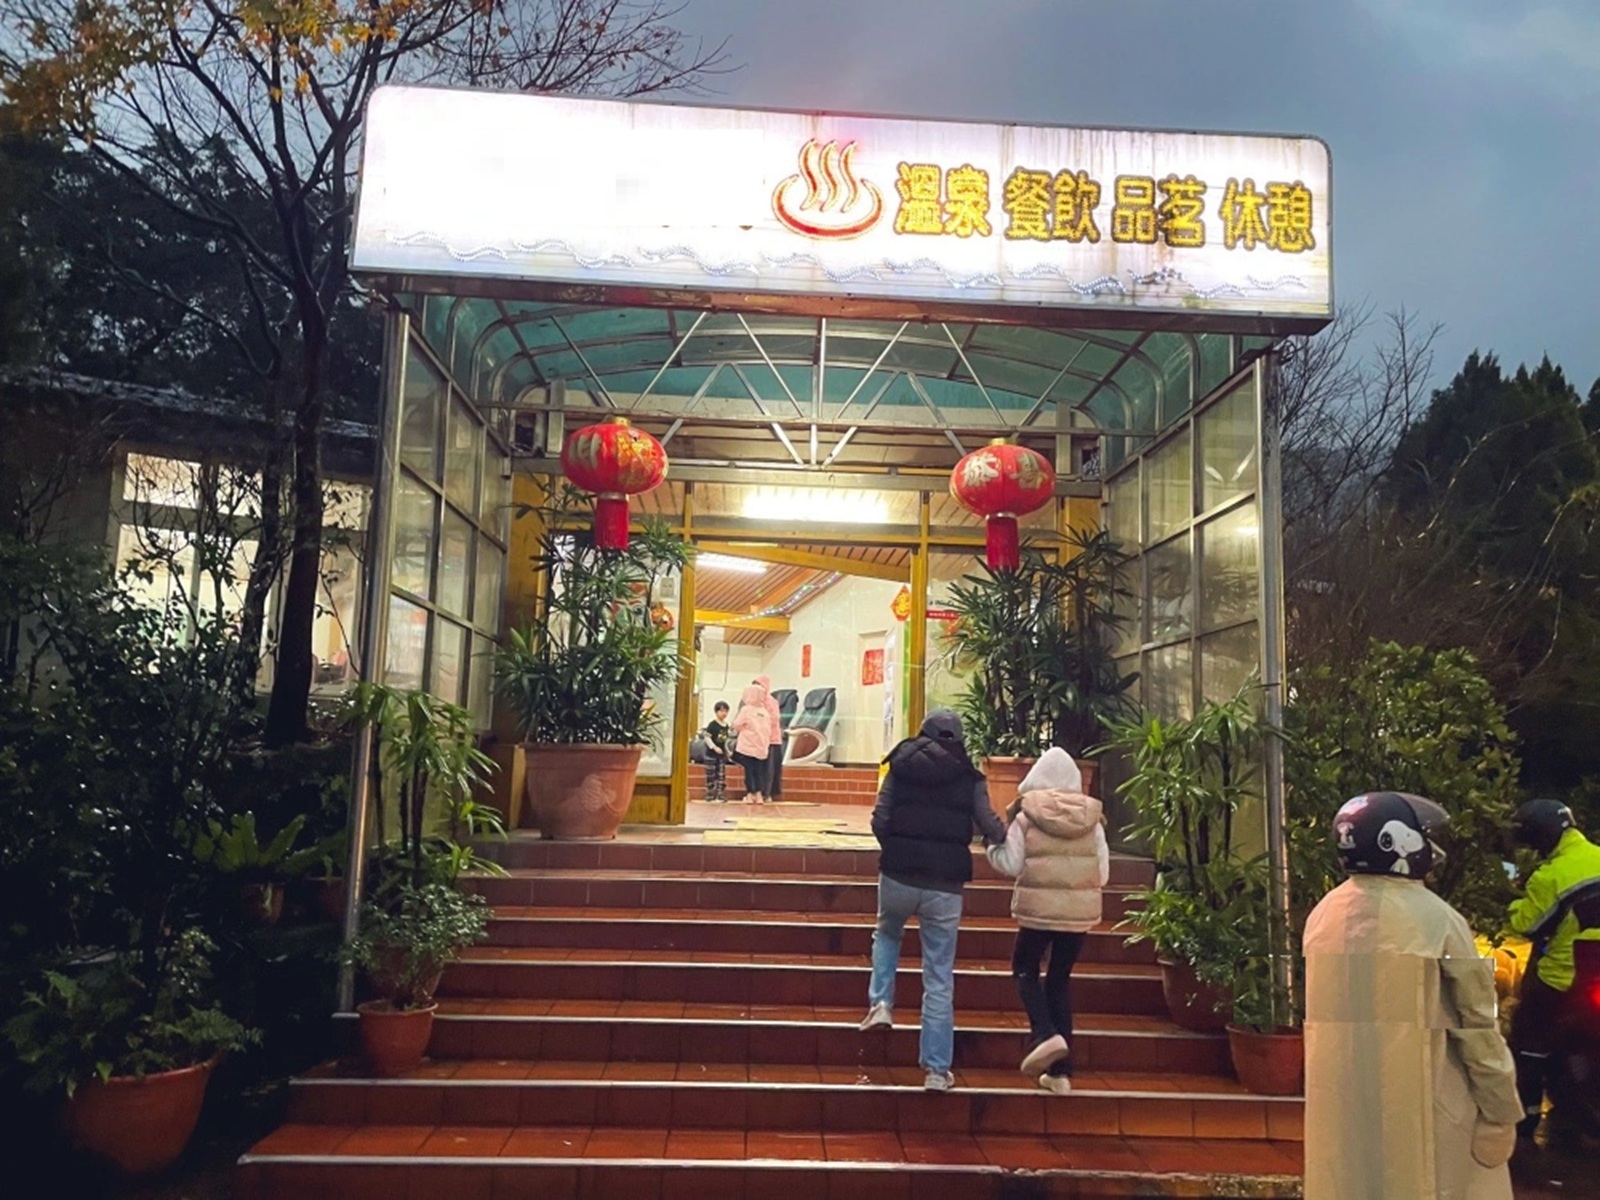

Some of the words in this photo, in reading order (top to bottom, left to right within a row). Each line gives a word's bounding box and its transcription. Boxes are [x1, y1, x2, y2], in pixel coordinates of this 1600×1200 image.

[894, 161, 993, 239] 溫泉
[1002, 166, 1101, 244] 餐飲
[1111, 173, 1207, 248] 品茗
[1218, 177, 1316, 253] 休憩
